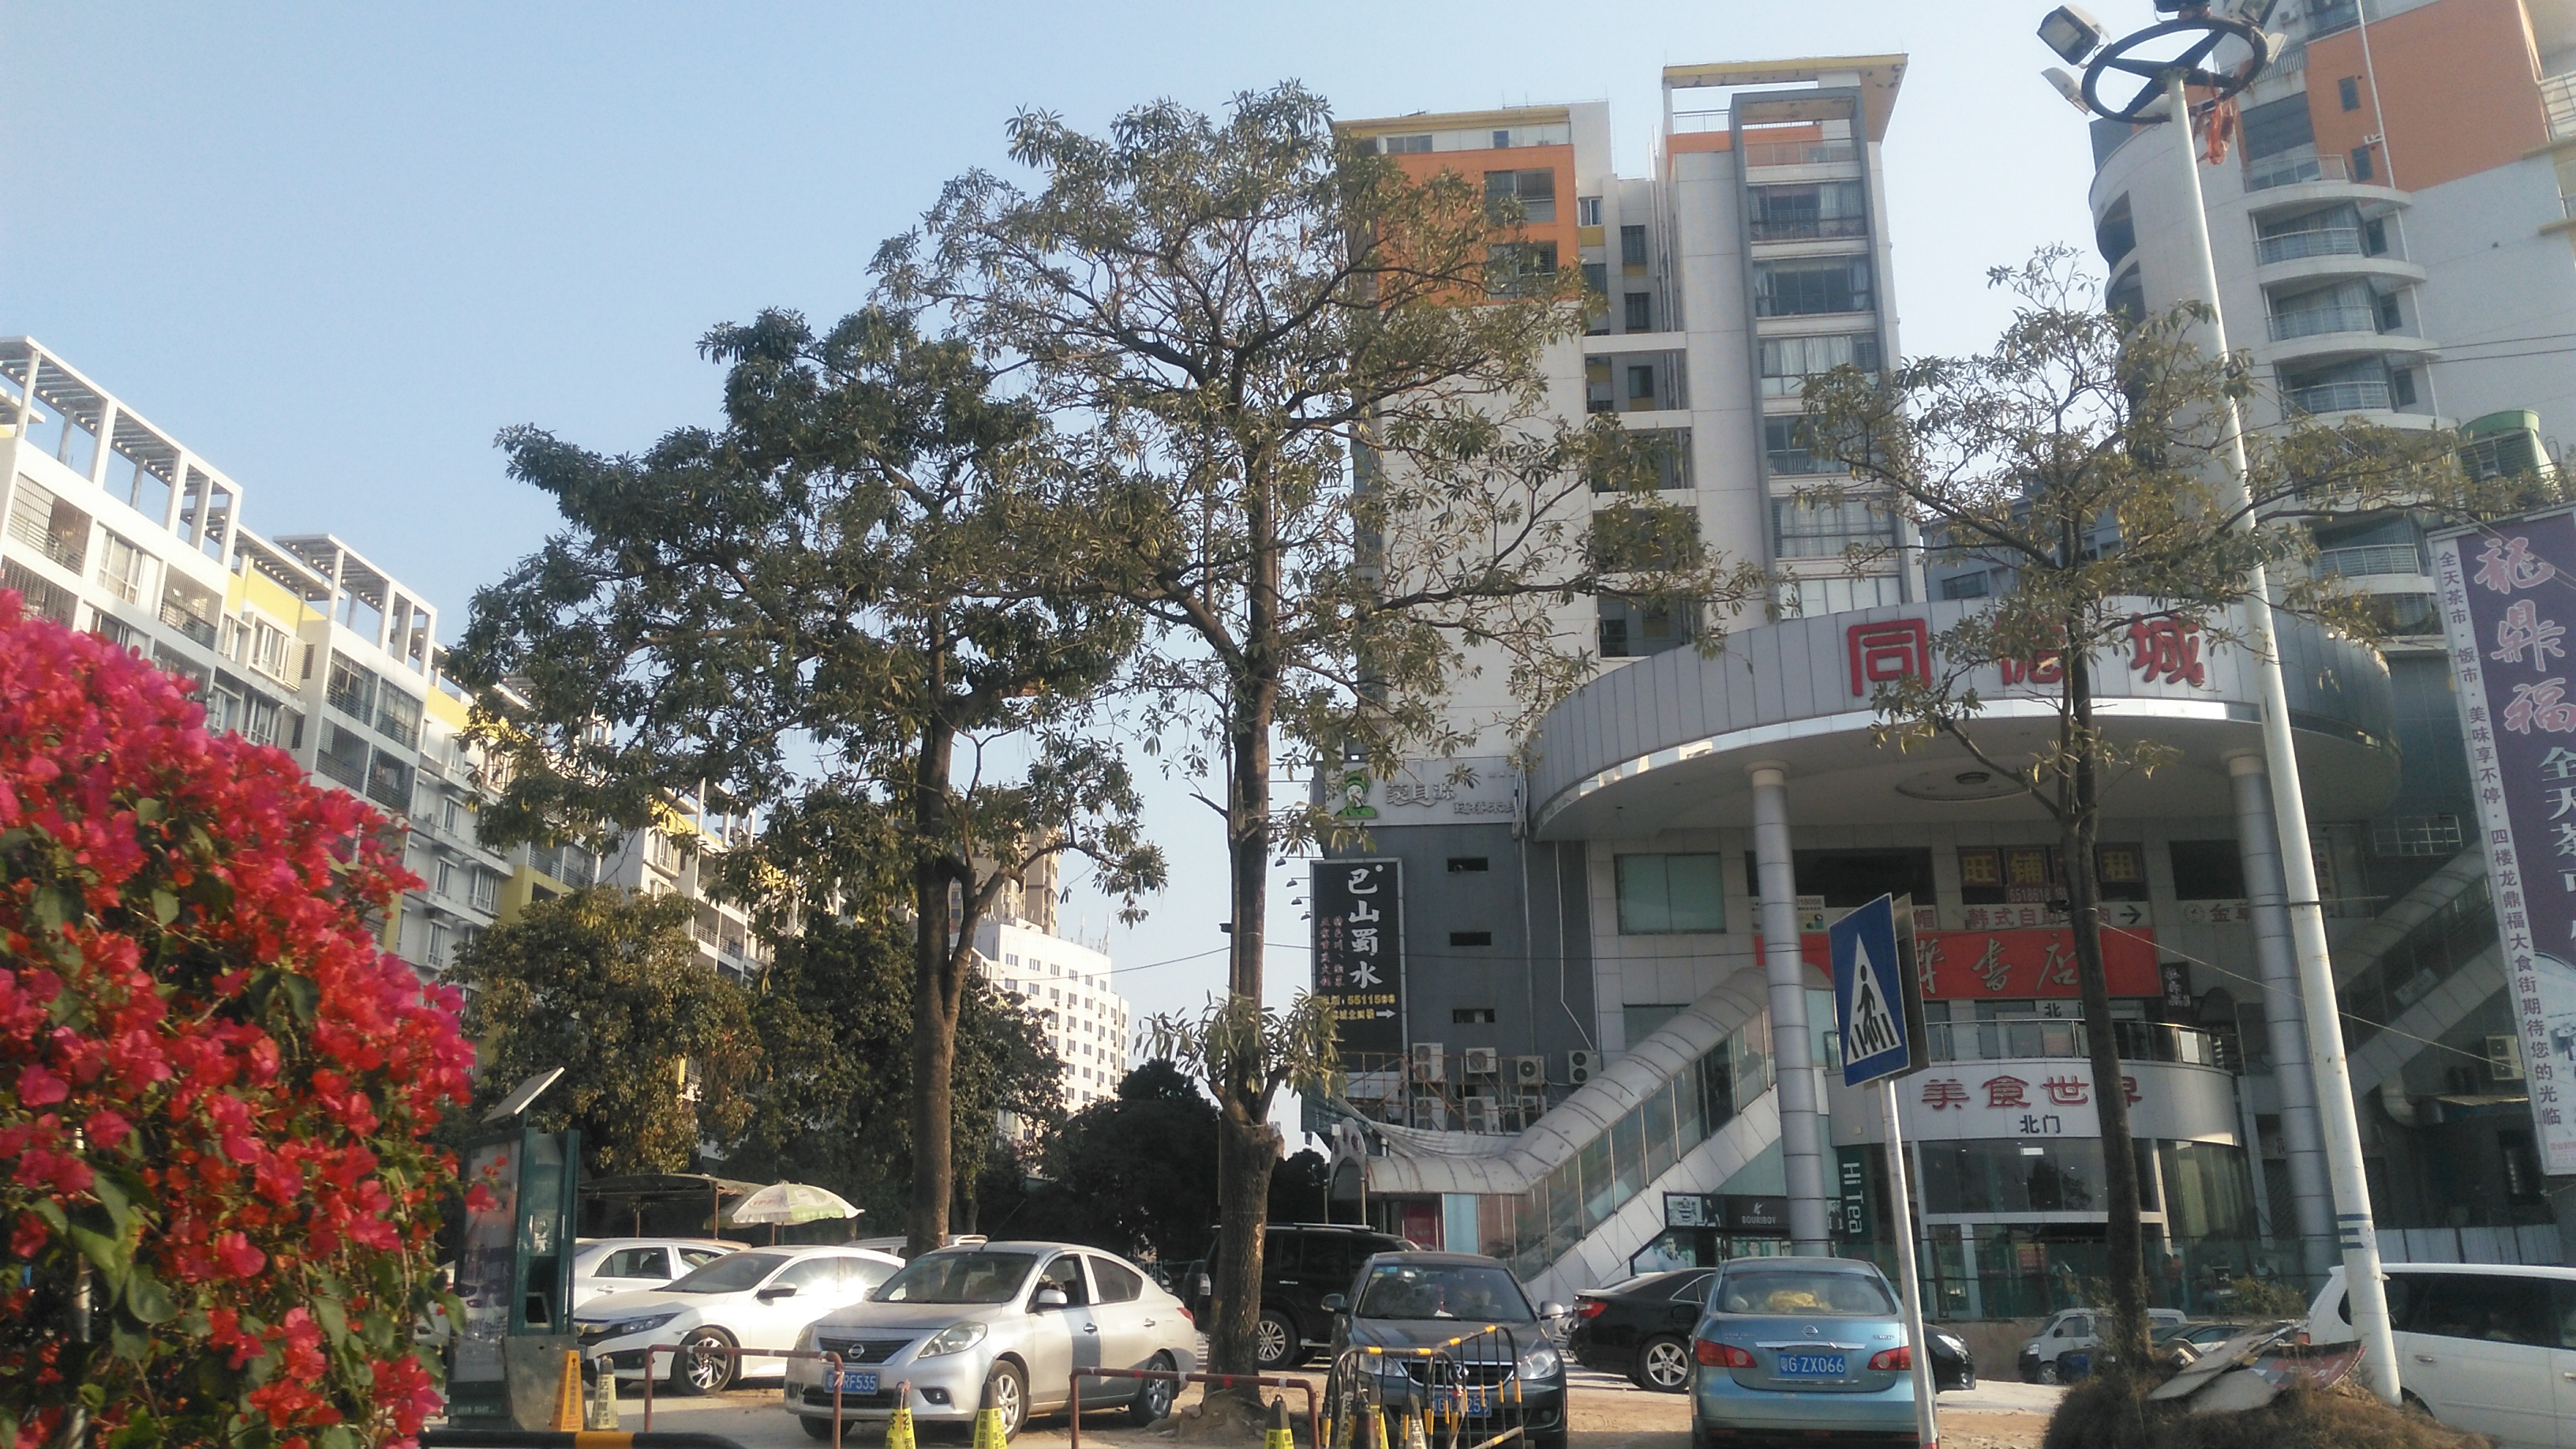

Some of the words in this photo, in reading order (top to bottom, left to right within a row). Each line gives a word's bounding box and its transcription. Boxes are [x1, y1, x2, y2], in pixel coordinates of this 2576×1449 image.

[1962, 851, 2140, 883] 旺铺租
[1348, 867, 1383, 990] 巴山蜀水
[2020, 1114, 2061, 1135] 北门
[1843, 1162, 1862, 1185] Hi
[1845, 1190, 1864, 1234] Tea
